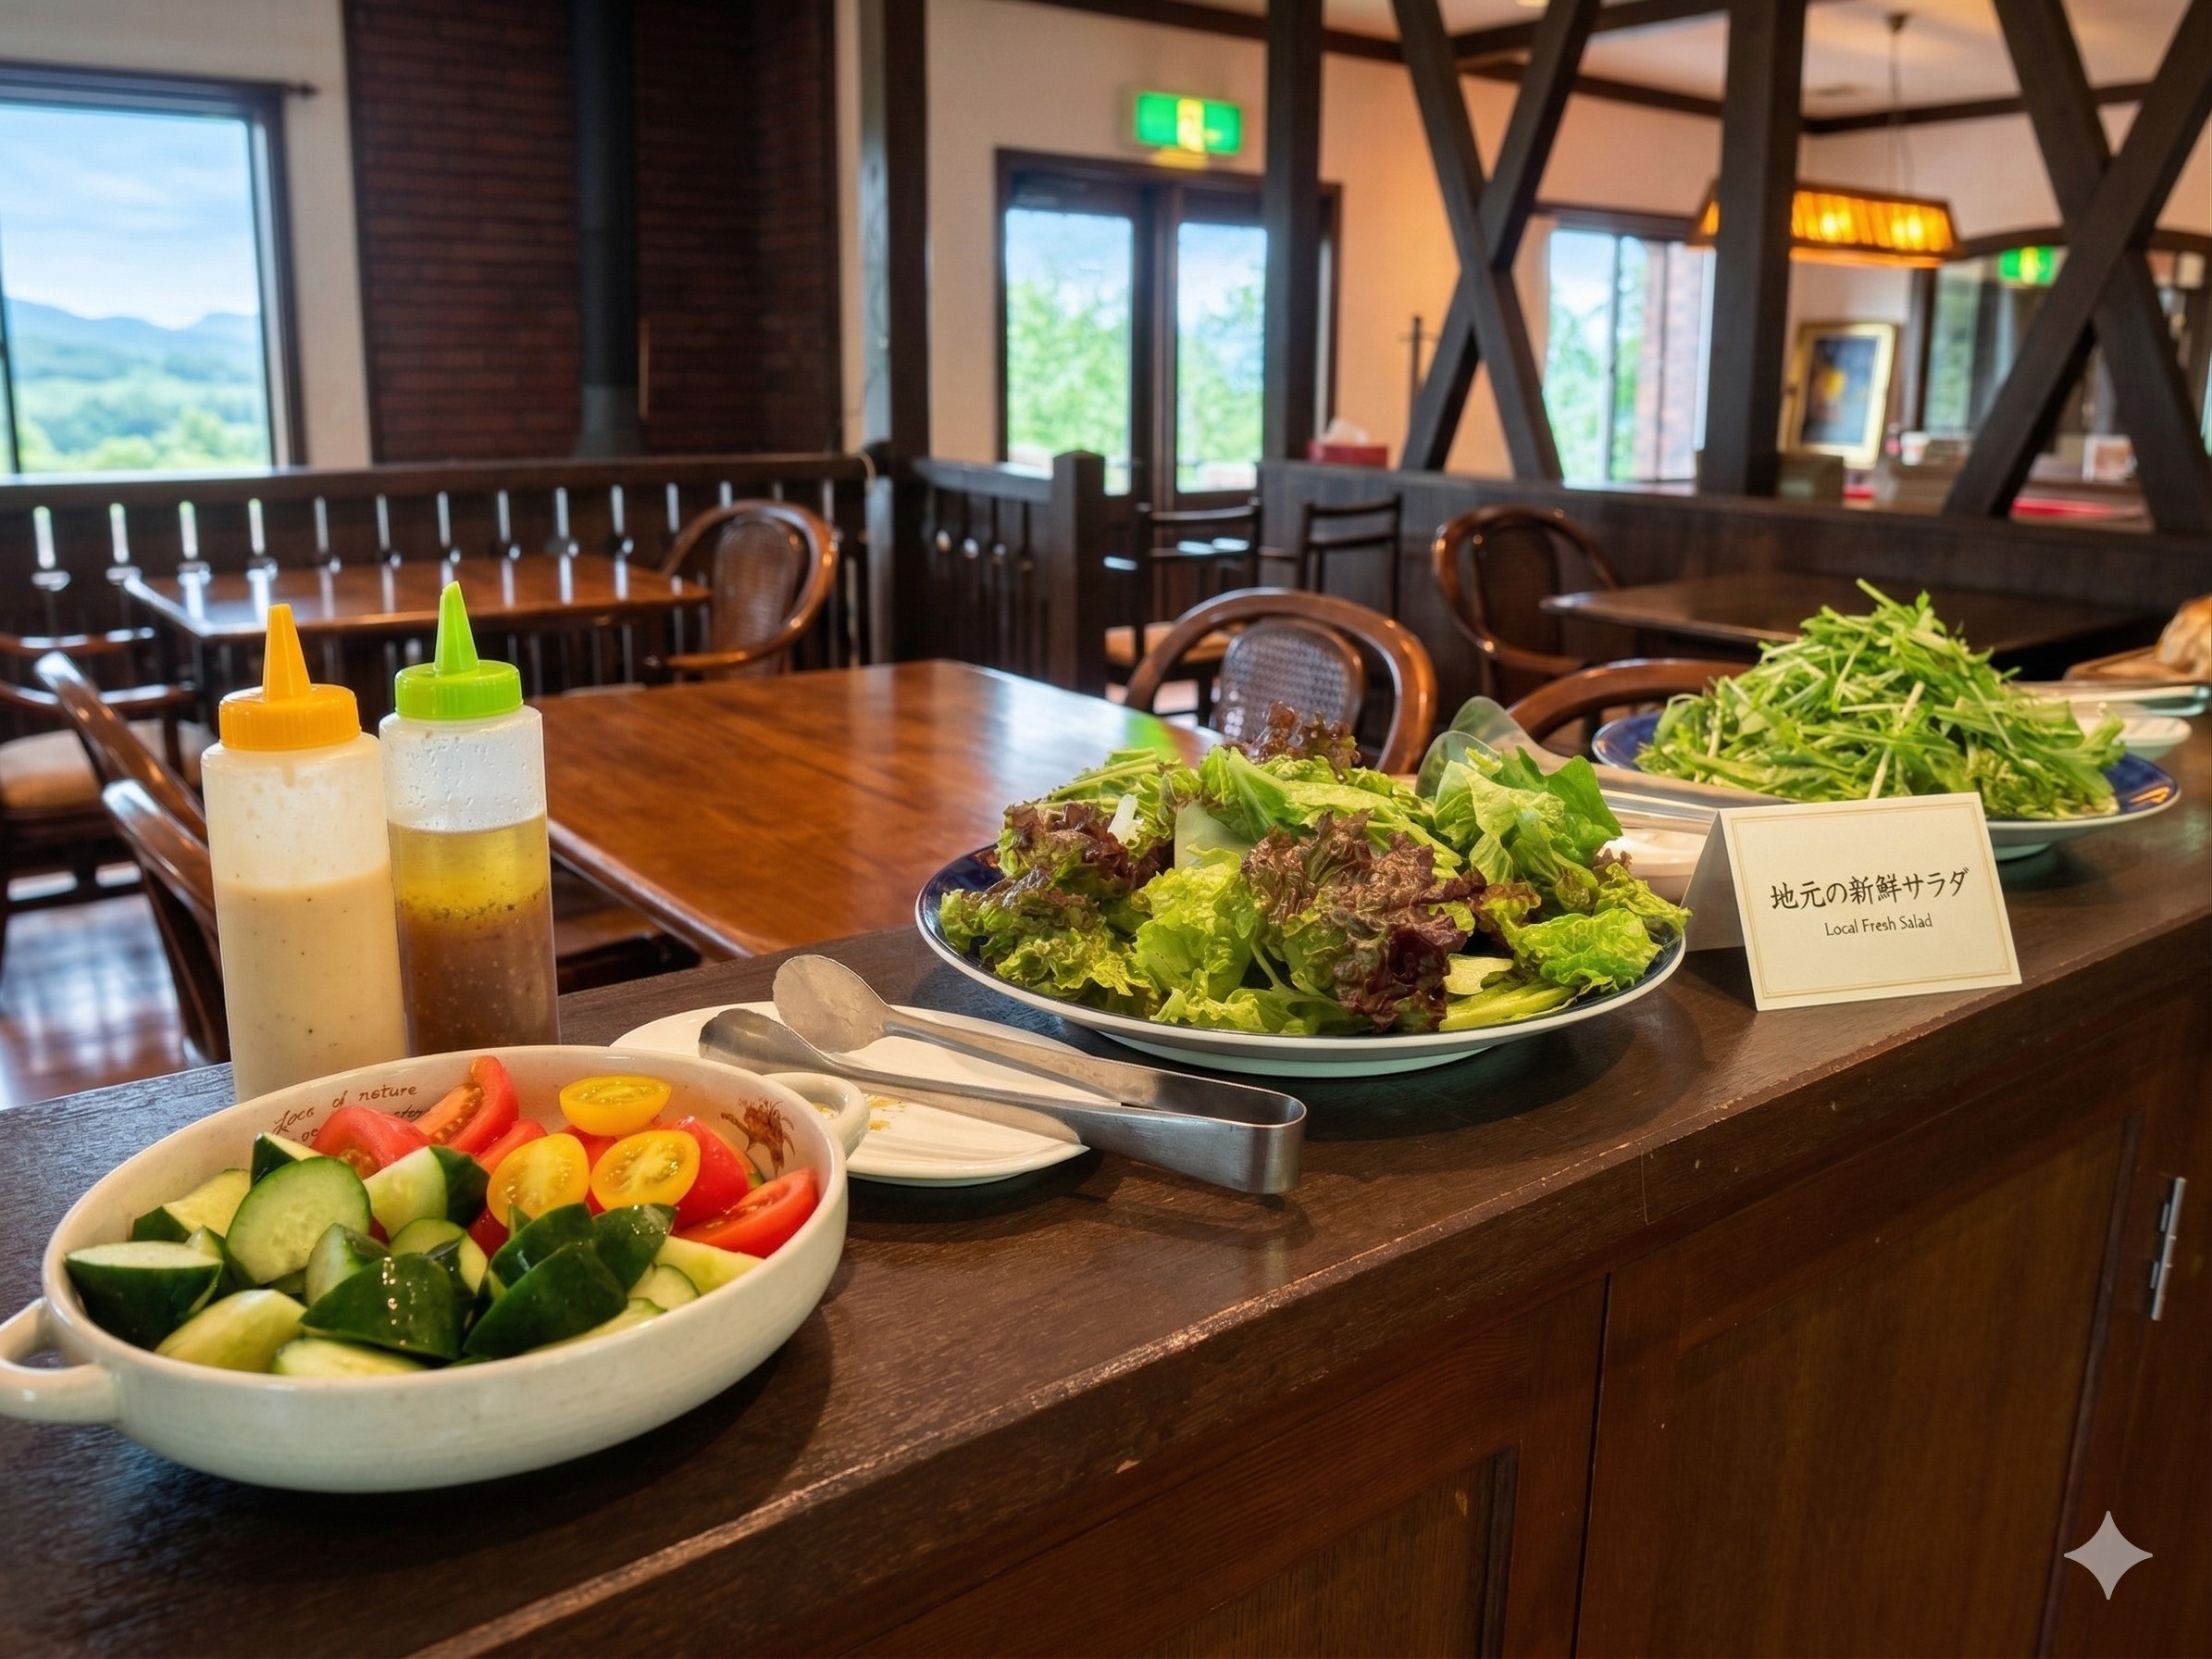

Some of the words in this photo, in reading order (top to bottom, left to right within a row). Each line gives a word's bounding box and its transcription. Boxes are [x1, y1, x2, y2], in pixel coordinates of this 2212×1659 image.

[1771, 867, 1970, 910] 地元の新鮮サラダ
[1824, 918, 1858, 937] Local
[1861, 916, 1897, 933] Fresh
[1899, 913, 1932, 930] Salad
